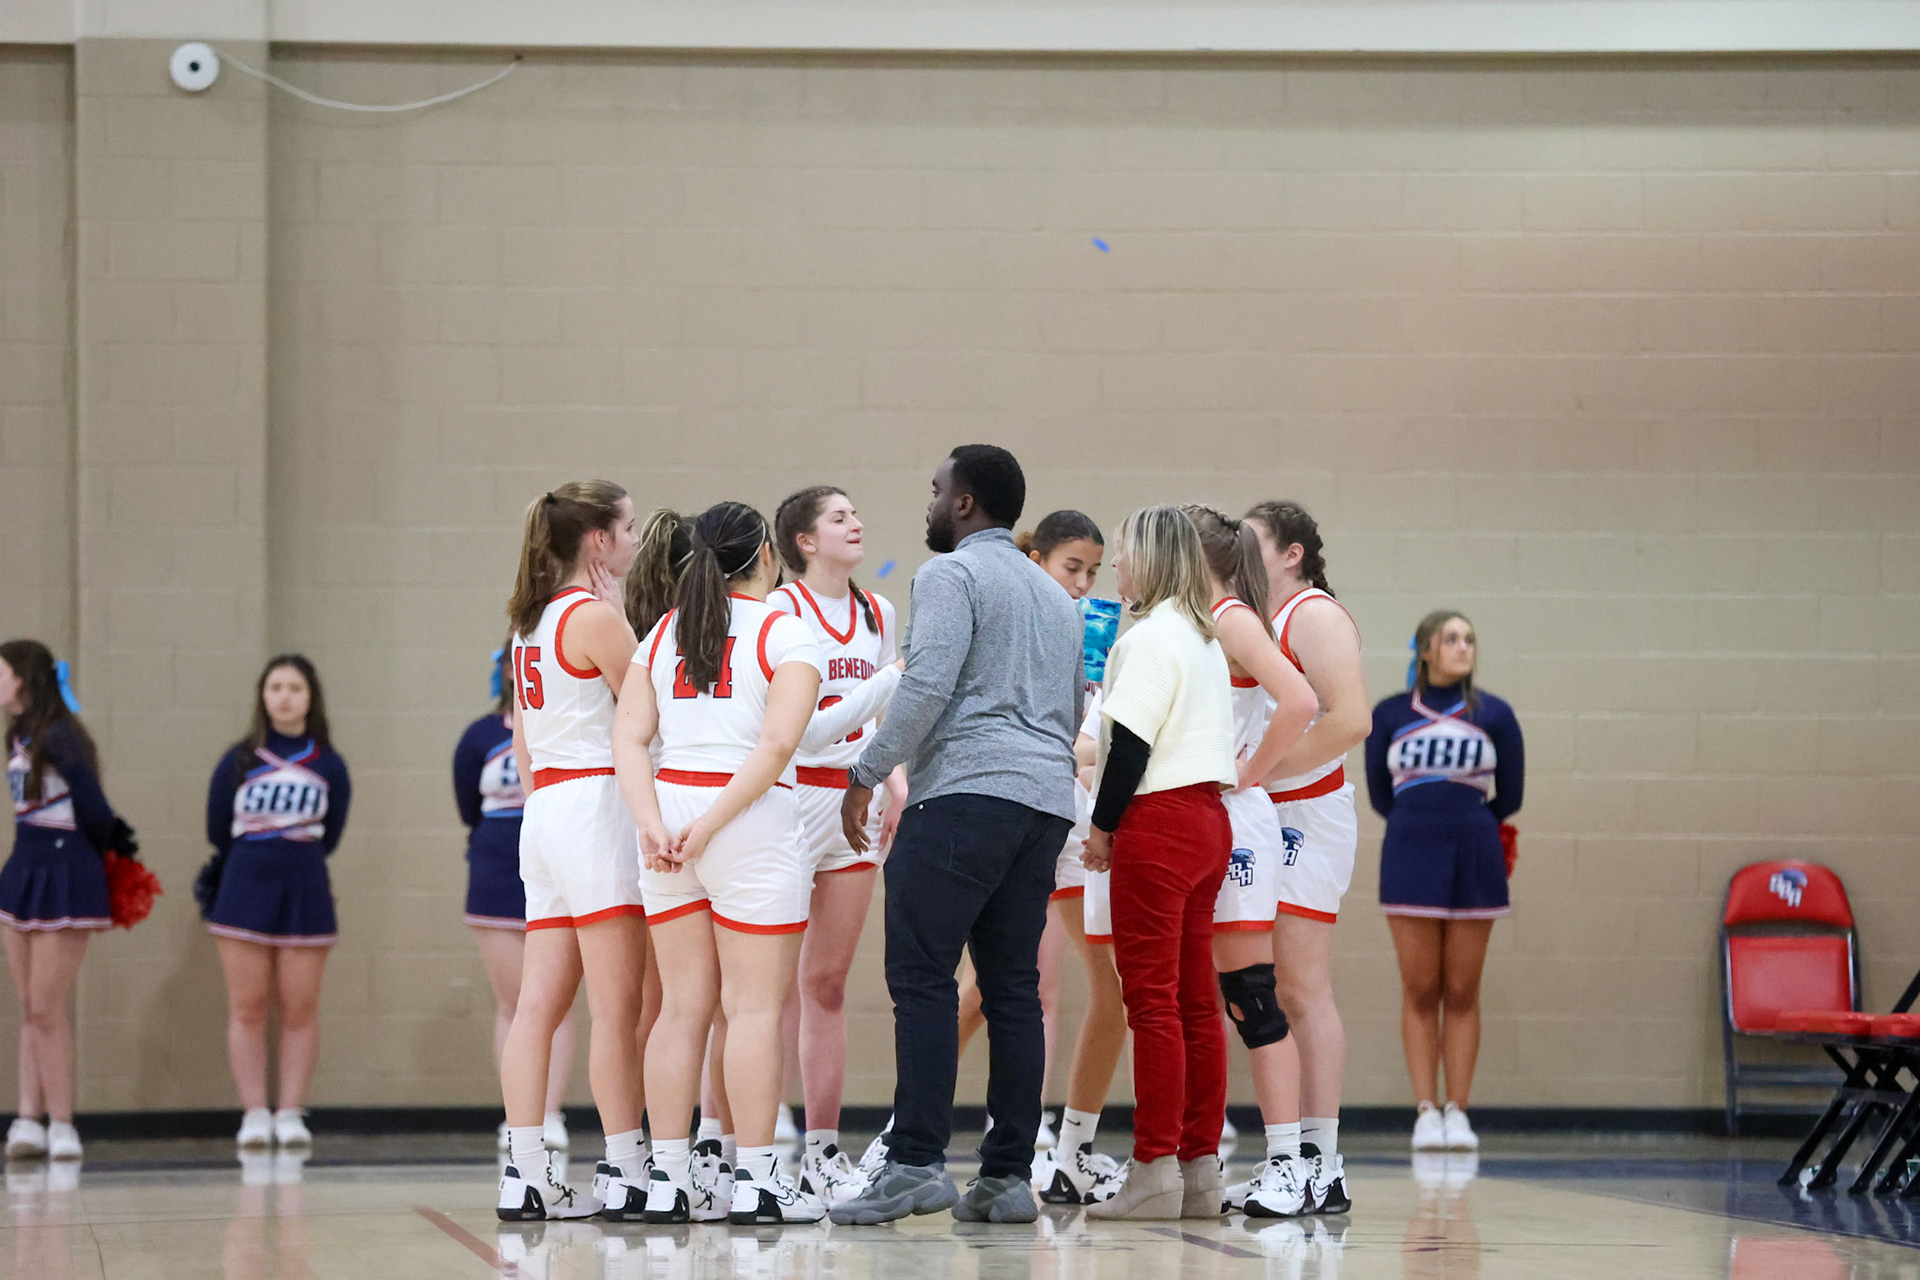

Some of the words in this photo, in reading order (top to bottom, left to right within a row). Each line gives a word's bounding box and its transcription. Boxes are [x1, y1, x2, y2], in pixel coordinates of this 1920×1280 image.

[514, 646, 545, 710] 15
[1401, 737, 1482, 770] SBA
[244, 780, 322, 816] SBA
